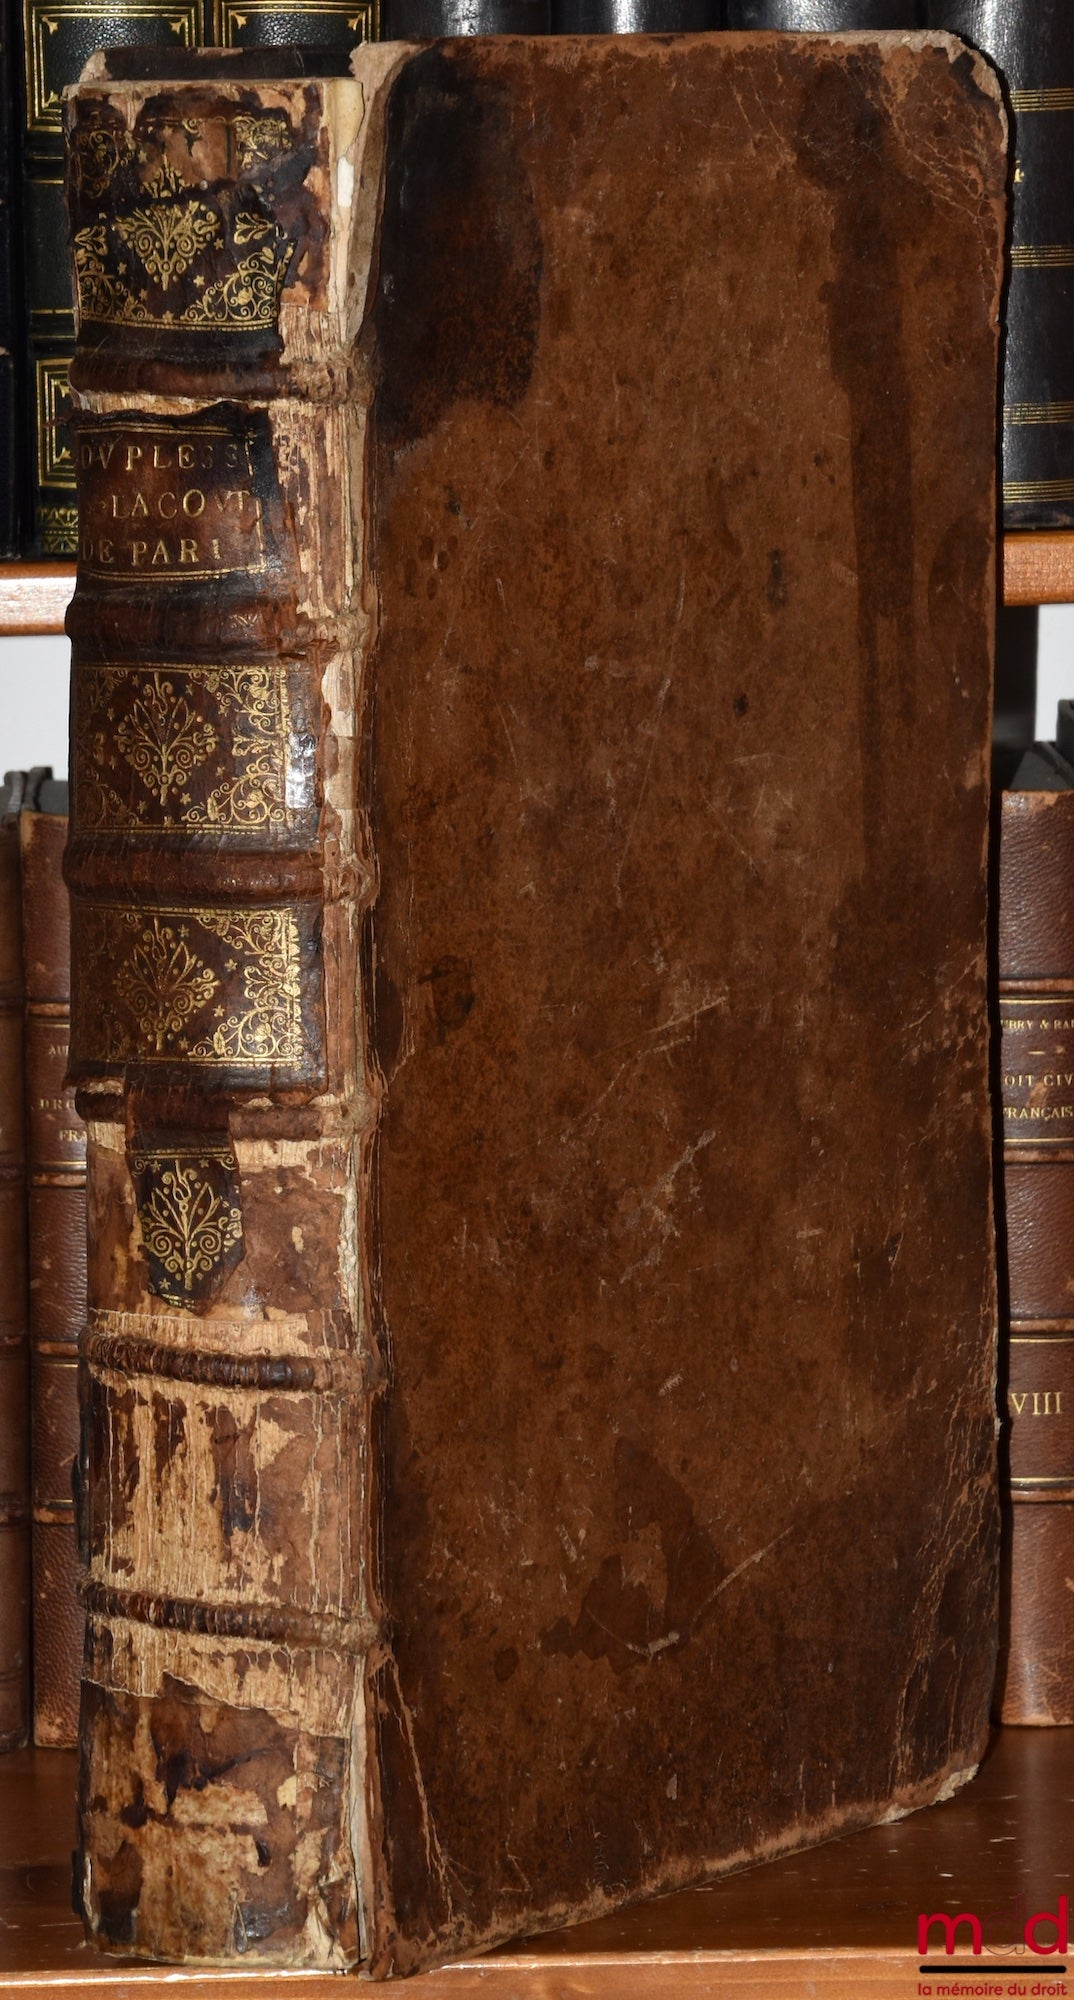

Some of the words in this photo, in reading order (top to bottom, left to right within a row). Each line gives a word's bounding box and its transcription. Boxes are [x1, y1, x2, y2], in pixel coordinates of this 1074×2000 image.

[82, 539, 115, 564] DE
[1040, 1020, 1049, 1030] &
[1004, 1074, 1035, 1087] OIT
[1043, 1074, 1073, 1087] CIV
[1011, 1391, 1063, 1415] VIII
